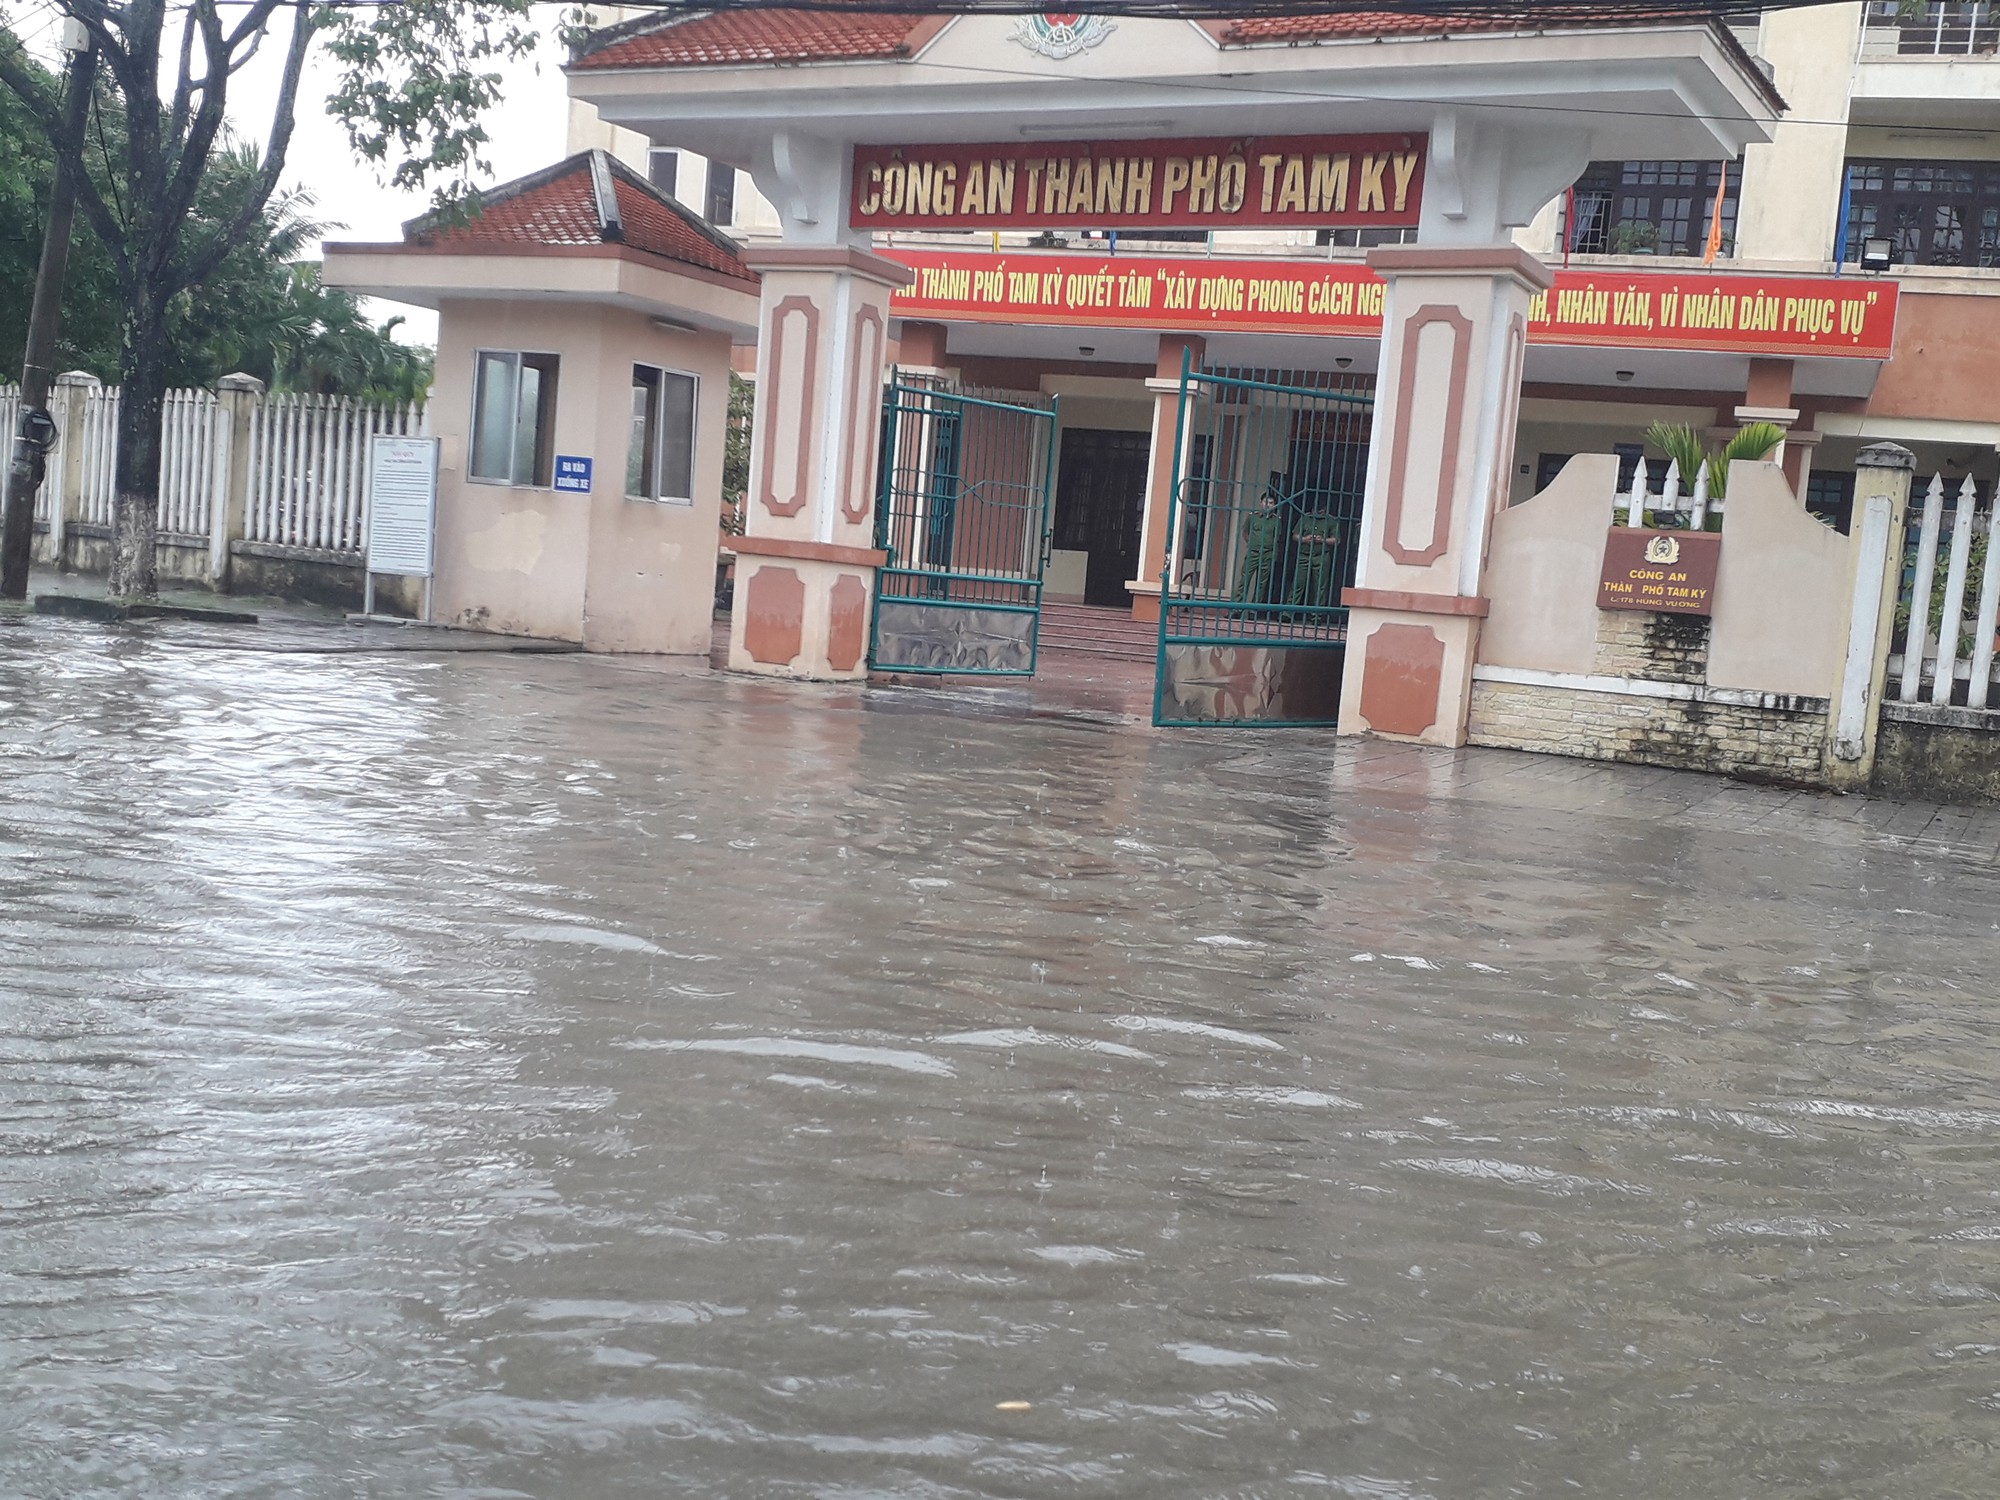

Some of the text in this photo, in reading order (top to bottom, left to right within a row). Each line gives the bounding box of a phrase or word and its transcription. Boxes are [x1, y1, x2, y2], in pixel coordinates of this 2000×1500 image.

[858, 136, 1420, 216] CÔNG AN THÀNH PHỐ TAM KỲ
[921, 262, 971, 301] THÀNH
[973, 260, 1006, 303] PHỐ
[1008, 271, 1039, 305] TAM
[1041, 266, 1064, 306] KỲ
[1065, 264, 1115, 310] QUYẾT
[1118, 269, 1152, 309] TÂM
[1198, 274, 1245, 318] DỰNG
[1246, 278, 1305, 314] PHONG
[1307, 274, 1355, 316] CÁCH
[1556, 283, 1609, 325] NHÂN
[1613, 284, 1654, 331] VĂN,
[1660, 286, 1679, 327] VÌ
[1681, 287, 1736, 330] NHÂN
[1738, 288, 1781, 332] DÂN
[1782, 297, 1836, 342] PHỤC
[1642, 583, 1665, 596] PHỐ
[1667, 586, 1689, 598] TAM
[1668, 572, 1687, 582] AN
